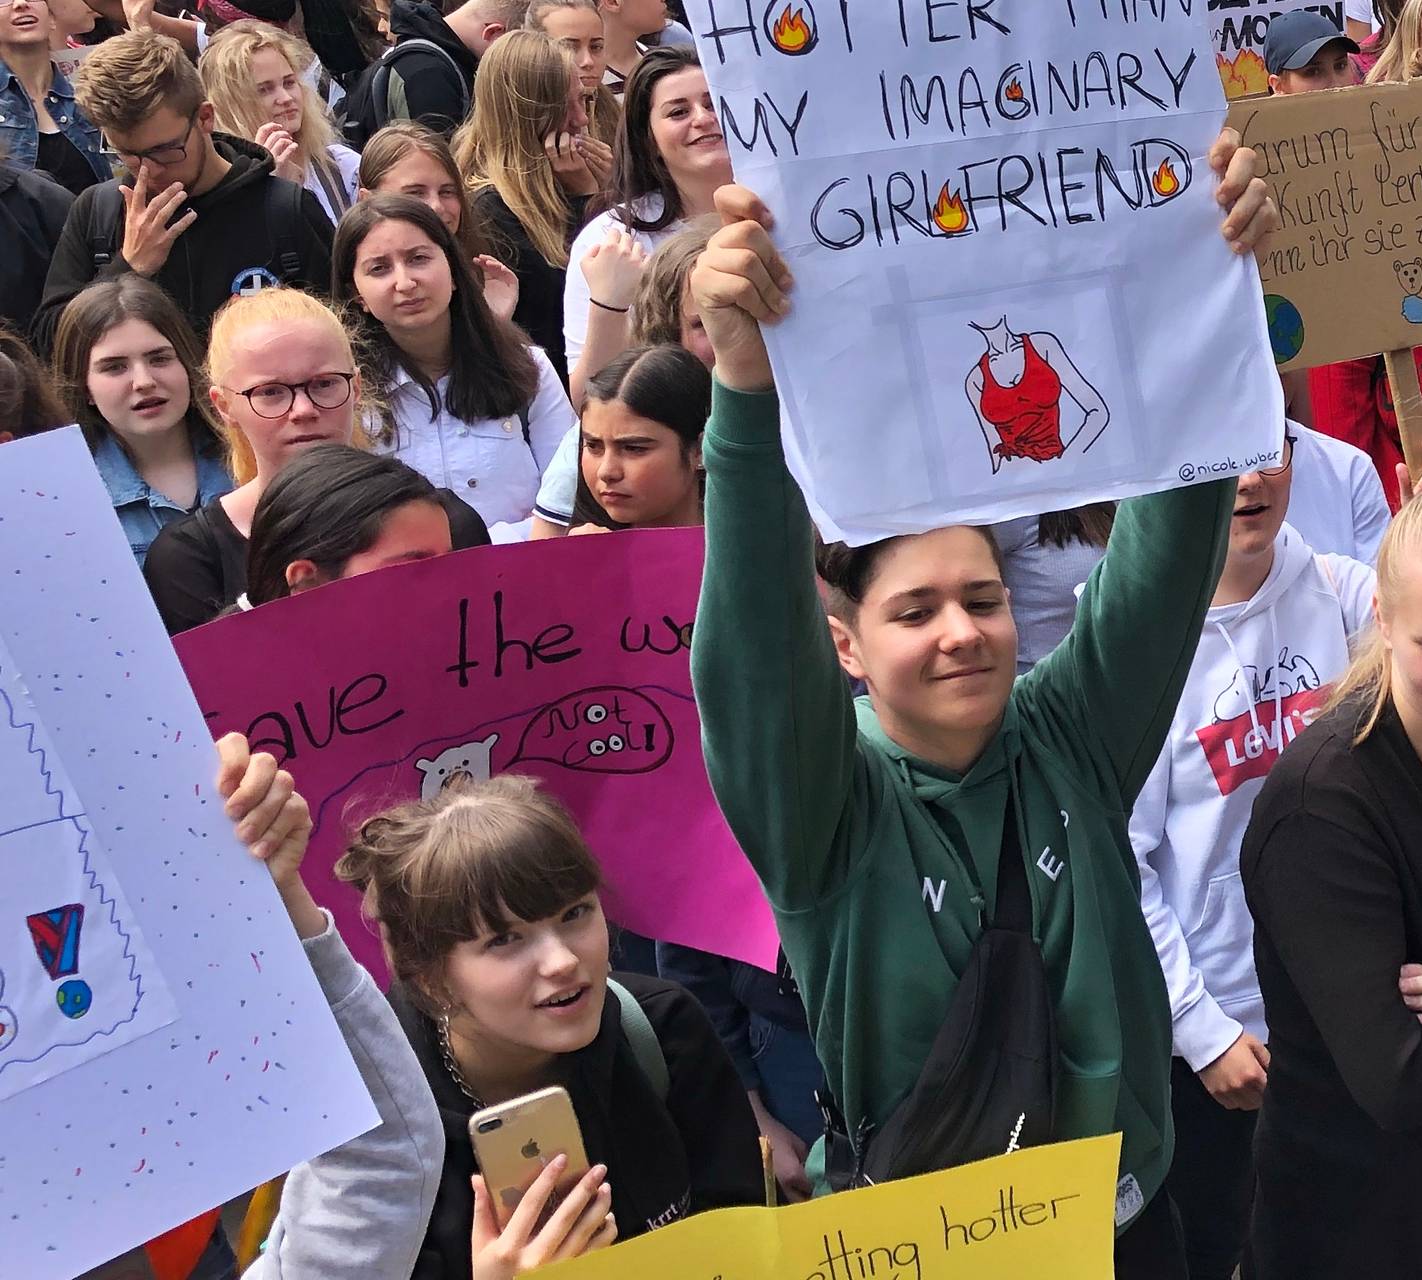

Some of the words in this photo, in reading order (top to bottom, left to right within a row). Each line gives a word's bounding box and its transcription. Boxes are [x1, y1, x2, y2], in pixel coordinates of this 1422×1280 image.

[720, 90, 808, 157] MY
[879, 48, 1197, 140] IMAGINARY
[1370, 101, 1421, 183] für
[811, 137, 1192, 251] GIRLFRIEND
[1309, 229, 1354, 266] ihr
[1364, 220, 1407, 254] sie
[203, 673, 405, 769] ave
[446, 590, 582, 688] the
[620, 615, 696, 655] wo
[805, 1230, 922, 1280] tting
[940, 1185, 1081, 1250] hotter
